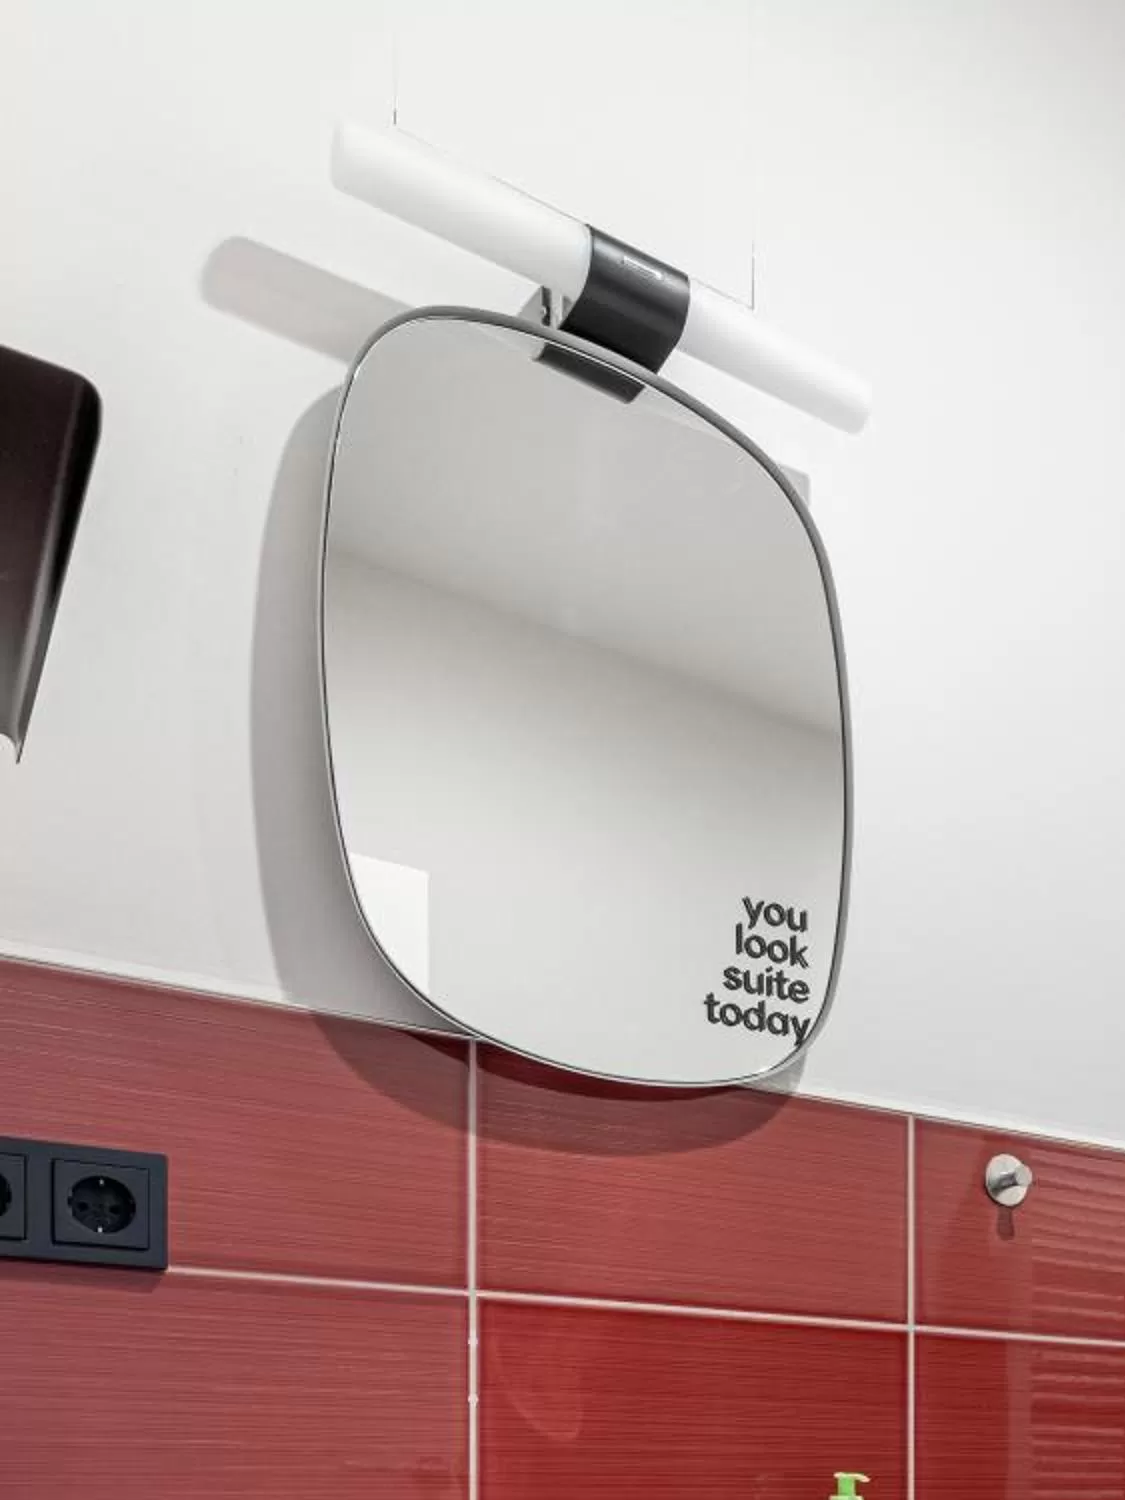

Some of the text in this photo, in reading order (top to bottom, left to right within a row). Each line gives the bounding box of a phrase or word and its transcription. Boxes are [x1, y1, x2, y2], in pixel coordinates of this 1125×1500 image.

[742, 896, 808, 933] you
[735, 923, 809, 969] look
[722, 966, 810, 1004] suite
[703, 992, 811, 1047] today
